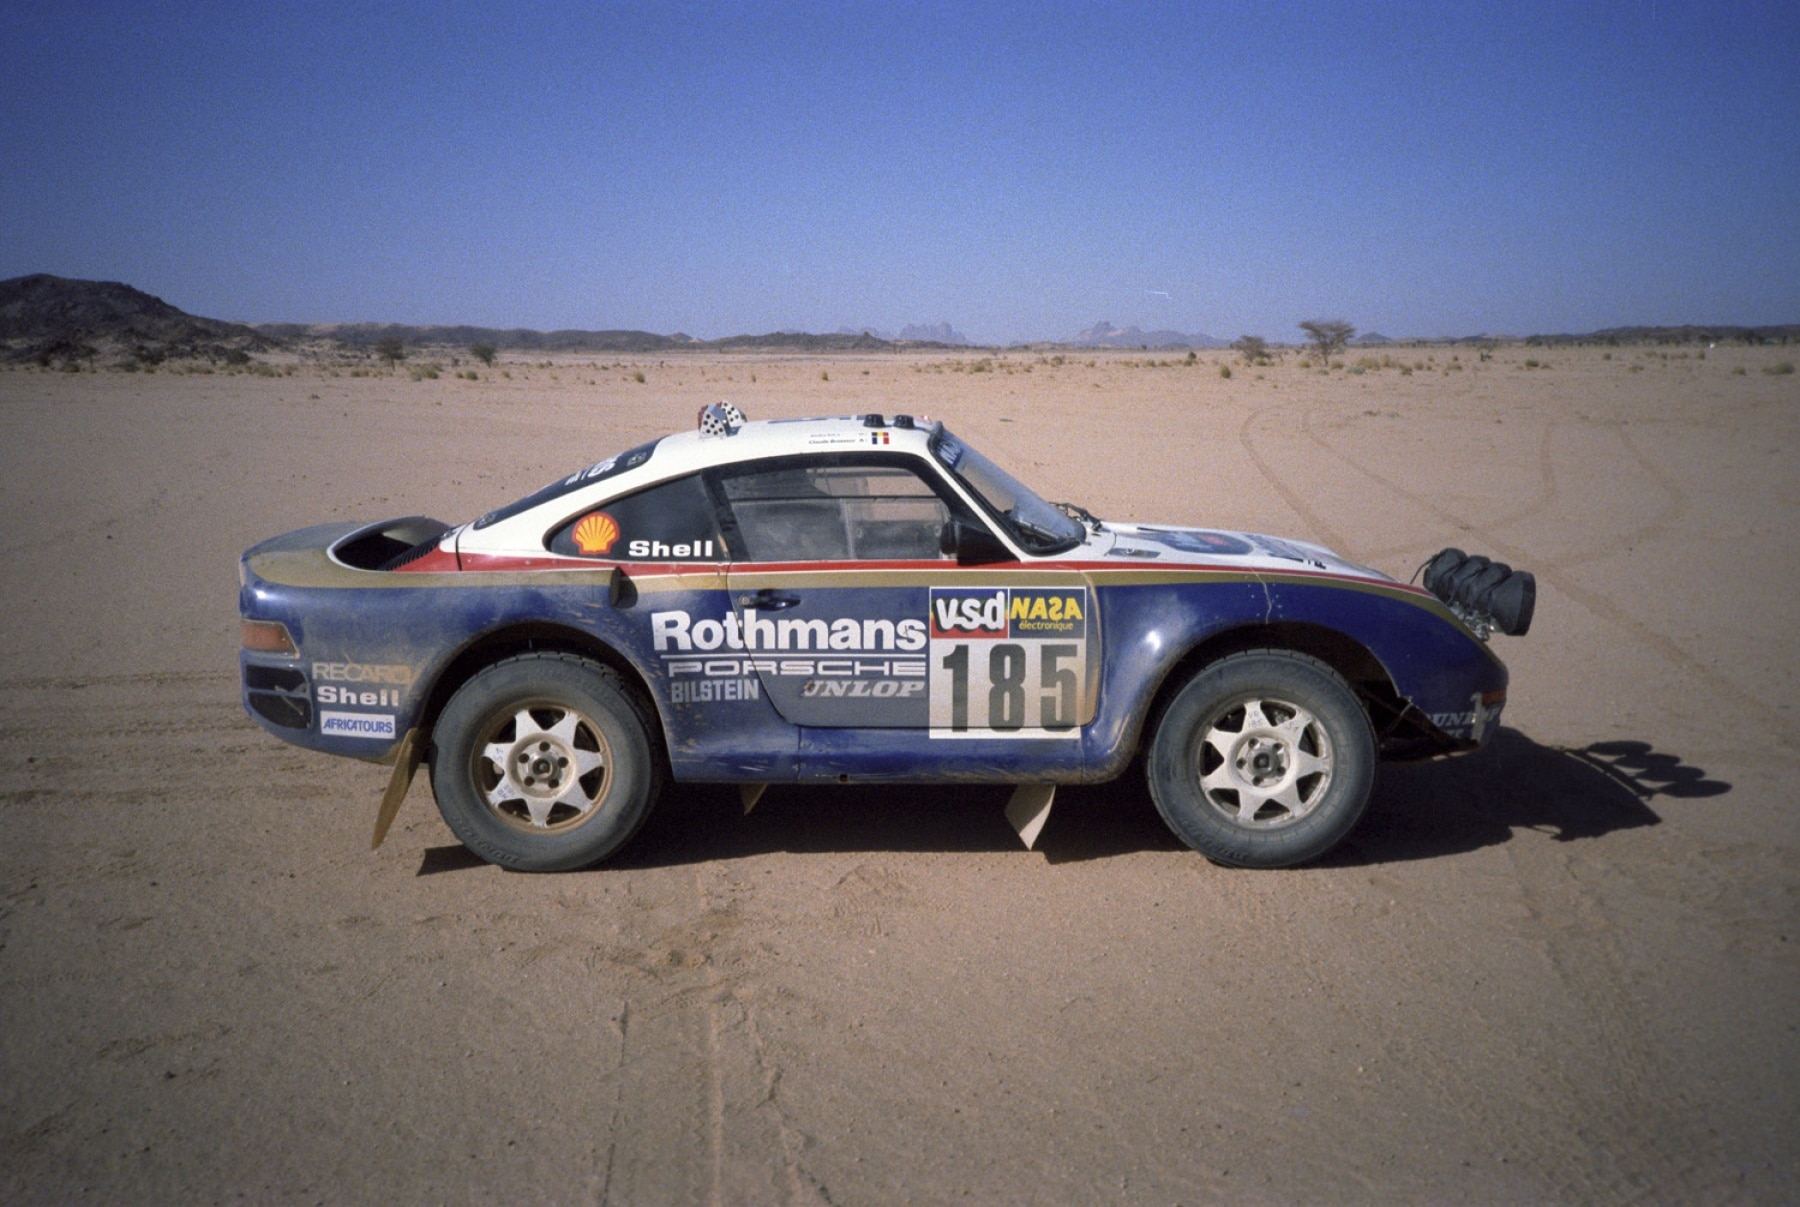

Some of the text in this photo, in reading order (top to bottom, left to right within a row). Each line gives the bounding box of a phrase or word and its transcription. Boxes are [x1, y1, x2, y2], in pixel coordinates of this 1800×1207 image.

[629, 540, 713, 557] Shell
[651, 609, 927, 651] Rothmans
[312, 662, 411, 685] RECARO
[668, 661, 927, 678] PORSCHE
[317, 685, 400, 707] Shell
[671, 679, 760, 704] BILSTEIN
[801, 679, 926, 699] UNLOP
[942, 643, 1078, 733] 185
[323, 717, 393, 734] AFRICATOURS
